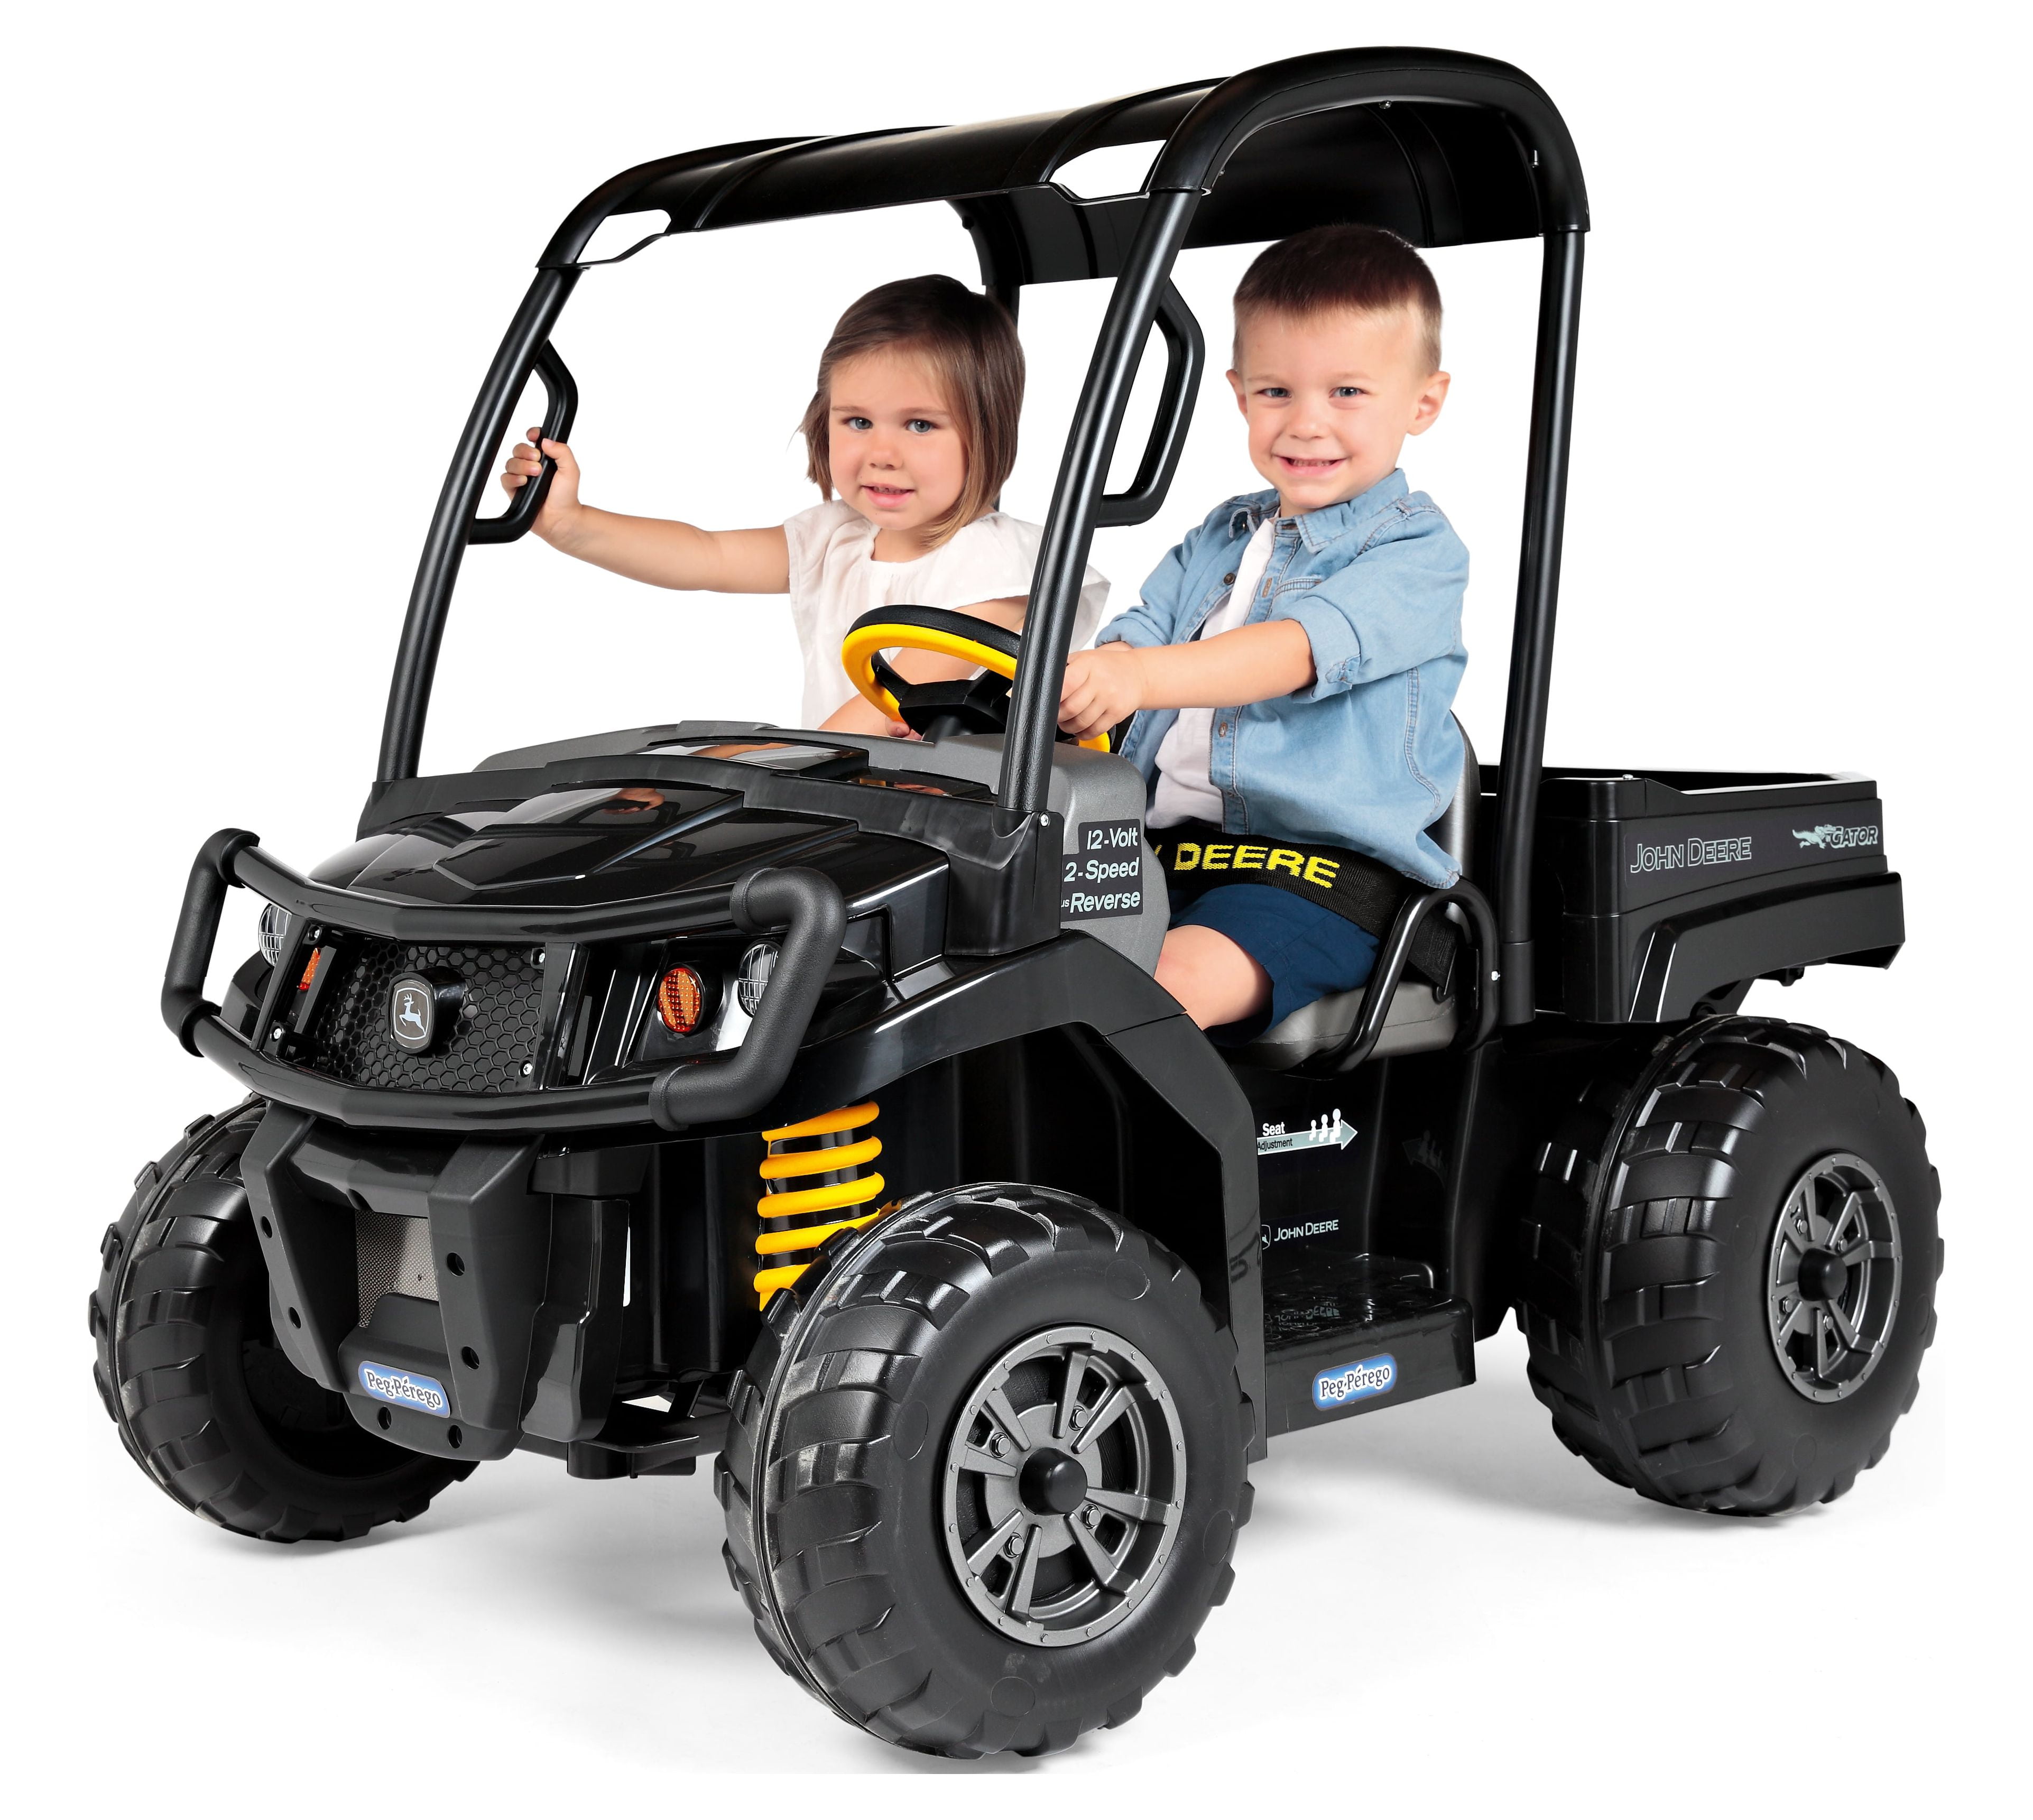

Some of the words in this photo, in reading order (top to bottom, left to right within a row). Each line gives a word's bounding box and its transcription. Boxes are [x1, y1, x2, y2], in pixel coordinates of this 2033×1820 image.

[1087, 827, 1138, 850] 12-Volt
[1830, 826, 1878, 848] GATOR
[1174, 843, 1341, 889] DEERE
[1631, 843, 1684, 873] JOHN
[1688, 837, 1751, 866] DEERE
[1064, 857, 1140, 883] 2-Speed
[1070, 892, 1141, 913] Reverse
[1262, 1122, 1286, 1137] Seat
[1258, 1138, 1293, 1151] Adjustment
[1274, 1227, 1304, 1241] JOHN
[1305, 1220, 1339, 1236] DEERE
